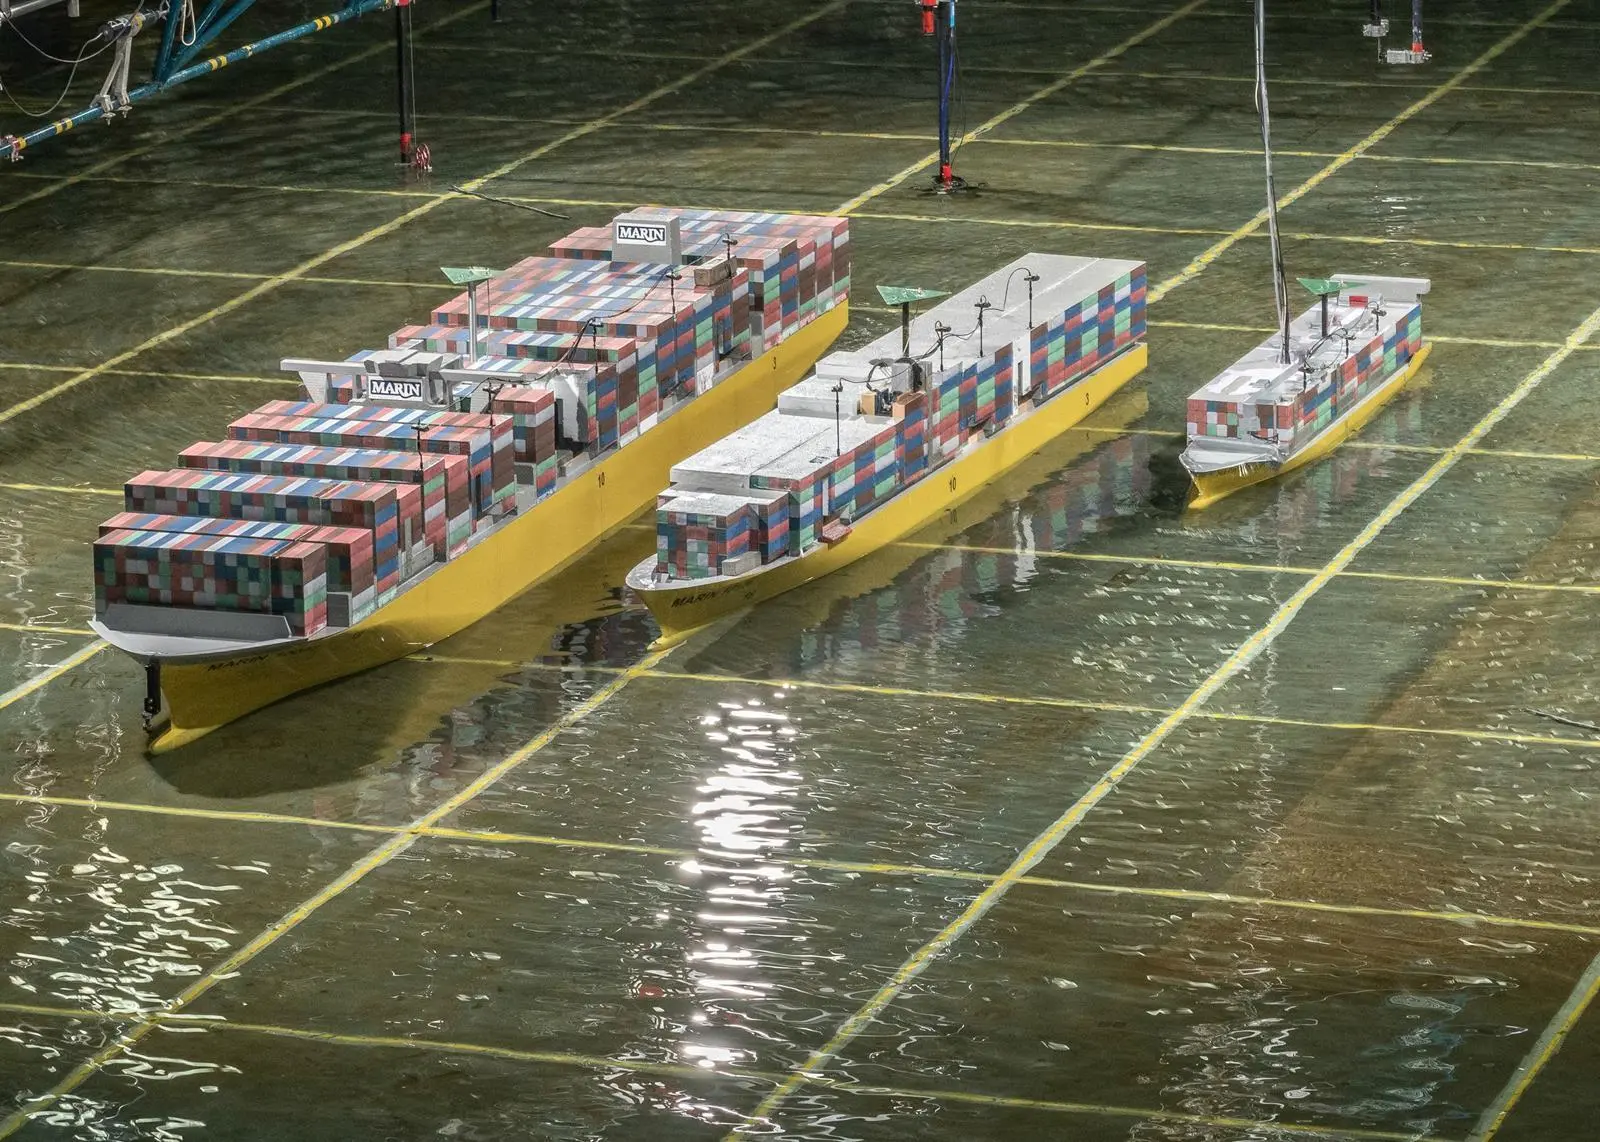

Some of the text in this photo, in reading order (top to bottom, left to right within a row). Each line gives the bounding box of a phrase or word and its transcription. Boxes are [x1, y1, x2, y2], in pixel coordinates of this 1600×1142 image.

[619, 226, 664, 242] MARIN
[371, 380, 420, 397] MARIN
[1085, 392, 1090, 406] 3
[598, 472, 606, 488] 10
[949, 476, 957, 492] 10
